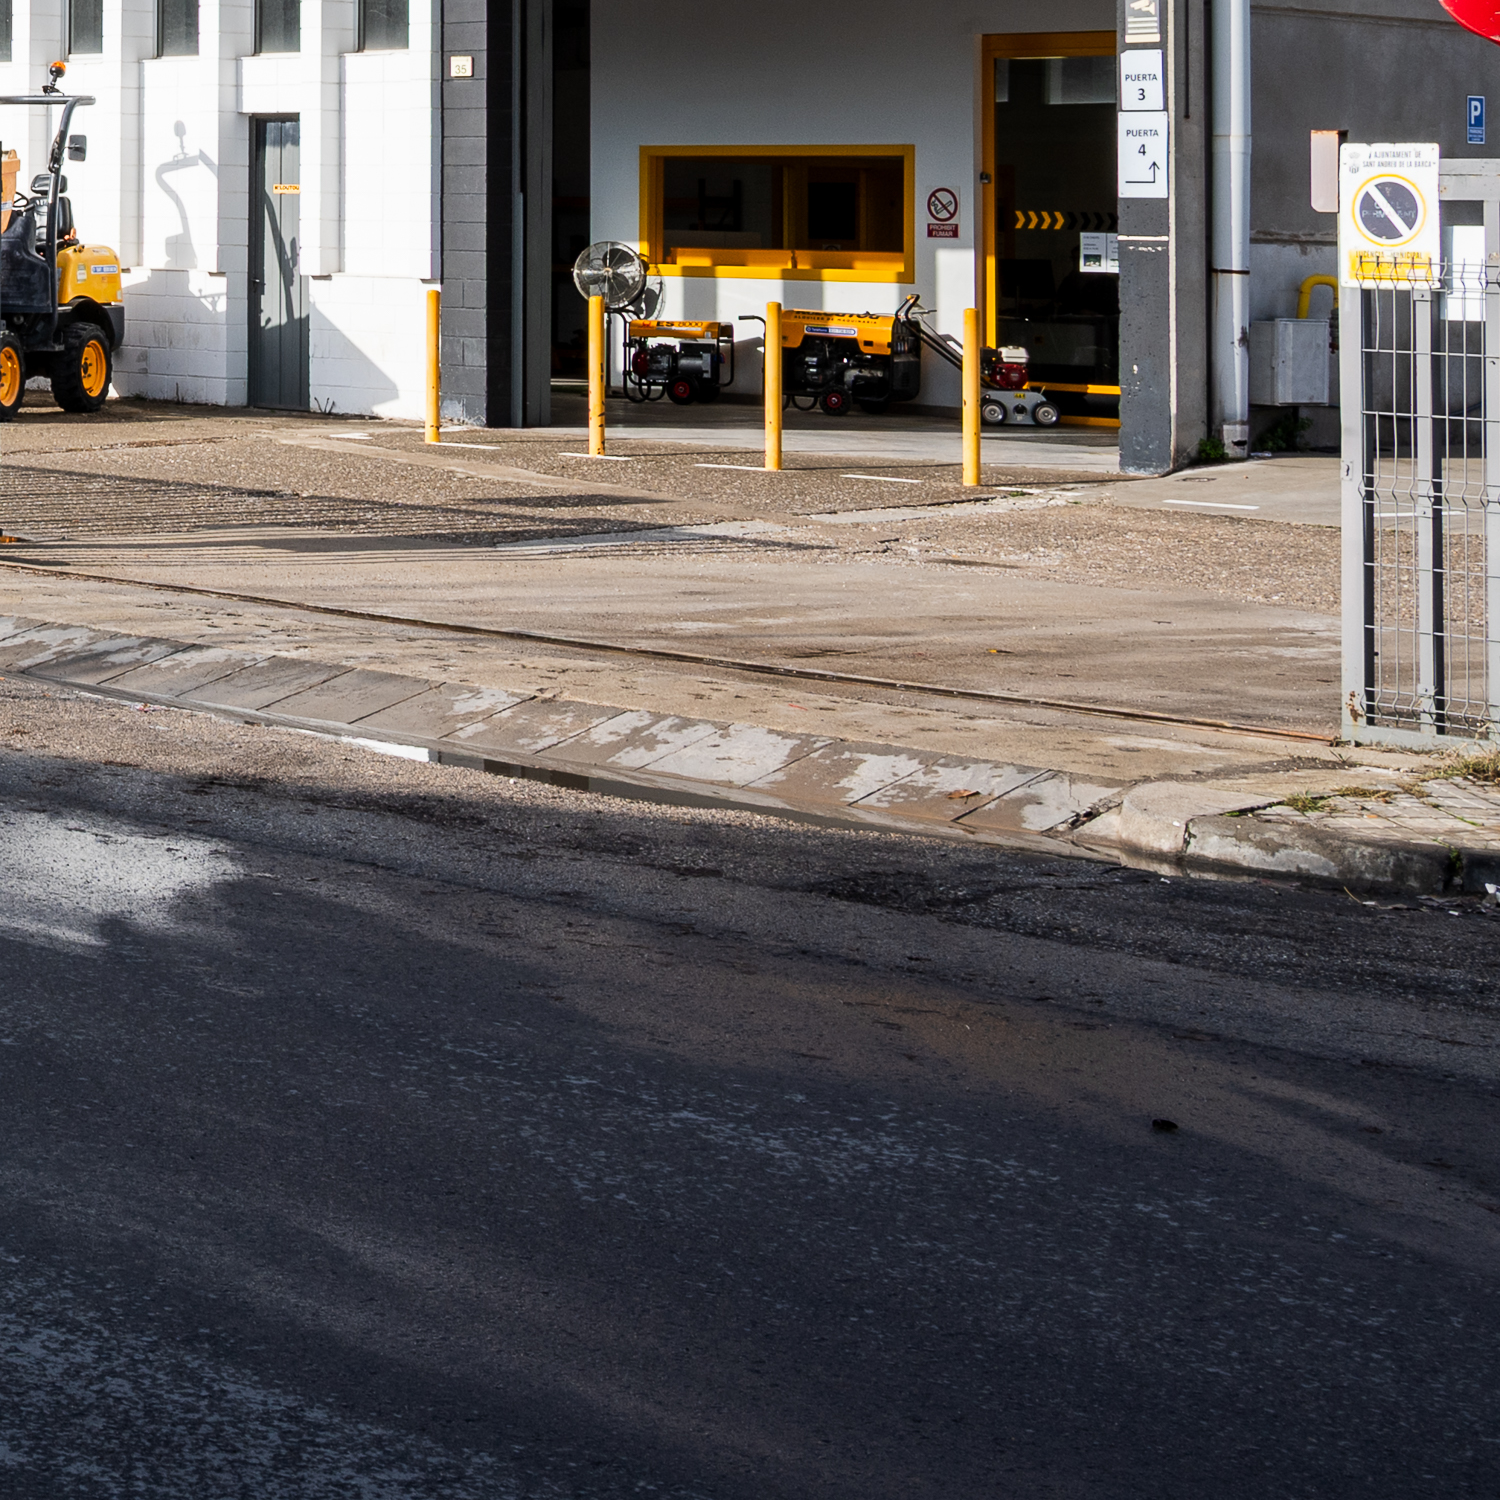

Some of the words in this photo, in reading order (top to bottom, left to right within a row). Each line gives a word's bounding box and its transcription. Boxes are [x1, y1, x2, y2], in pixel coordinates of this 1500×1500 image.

[455, 65, 466, 74] 35
[1125, 73, 1158, 82] PUERTA
[1138, 88, 1146, 101] 3
[1471, 101, 1481, 124] P
[1126, 129, 1159, 137] PUERTA
[1138, 144, 1146, 156] 4
